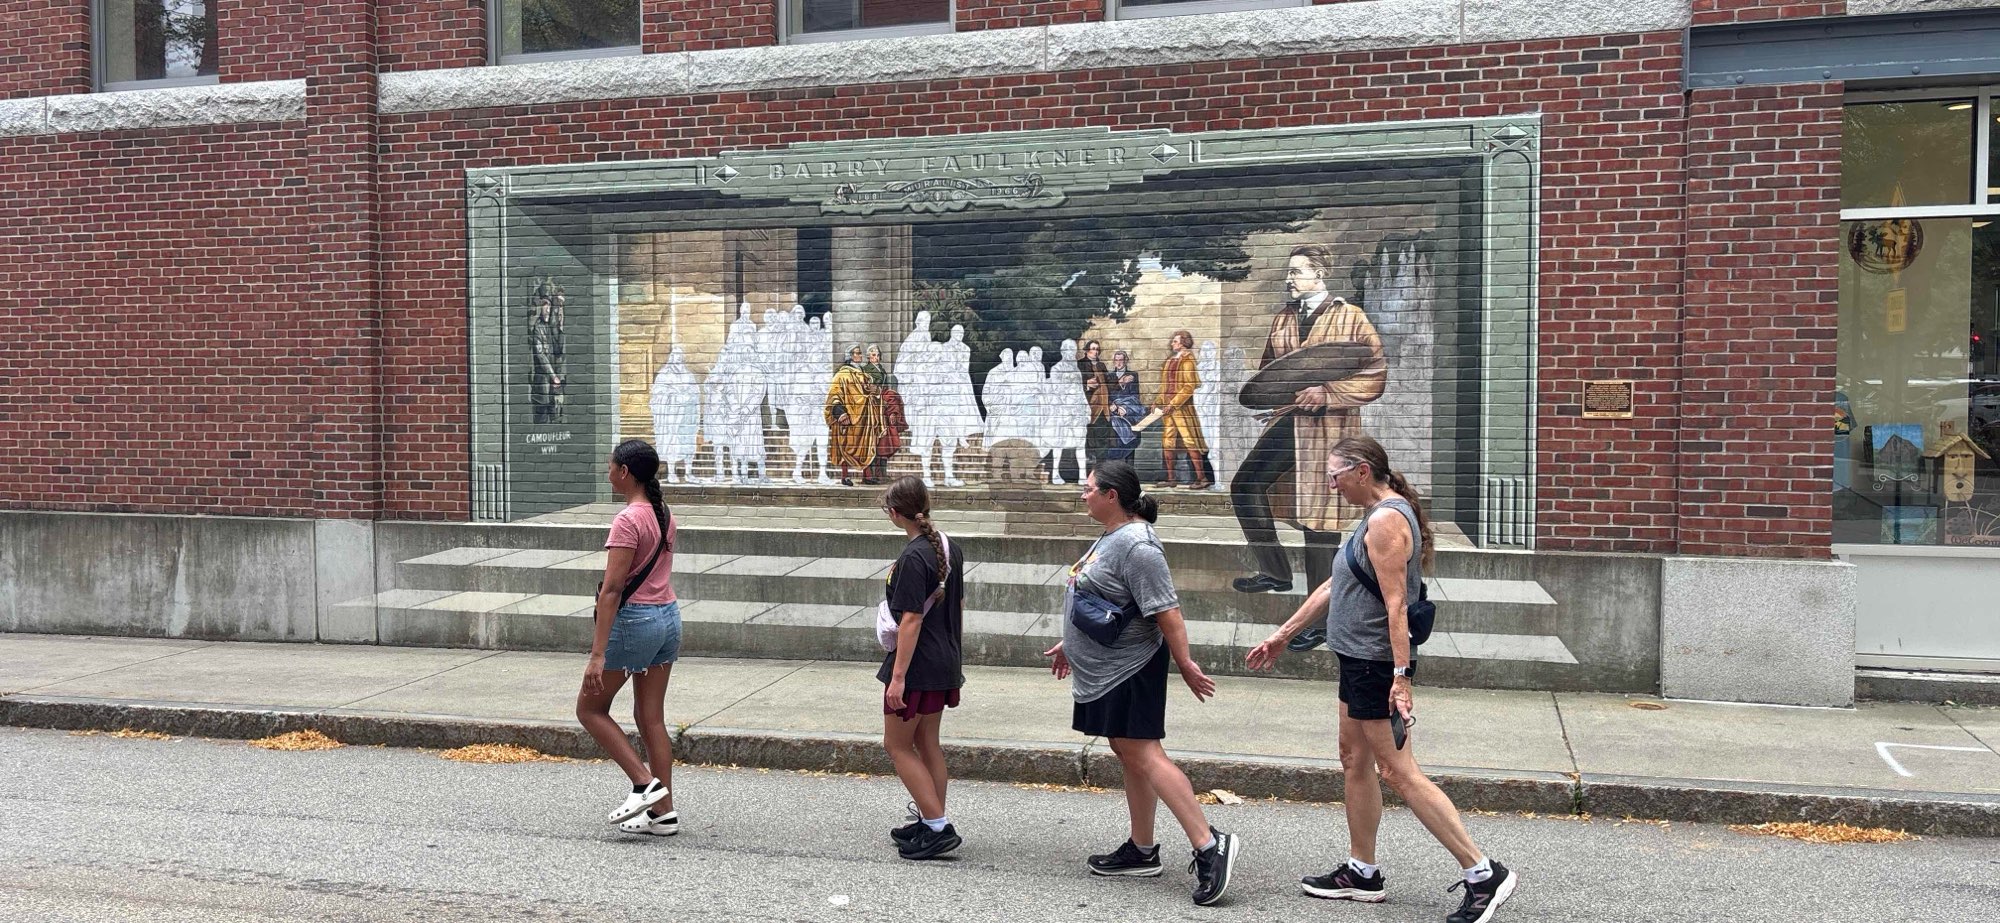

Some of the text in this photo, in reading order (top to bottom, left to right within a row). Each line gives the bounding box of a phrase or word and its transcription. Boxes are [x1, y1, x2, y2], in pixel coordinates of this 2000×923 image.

[769, 147, 1126, 180] BARRY FAULKNER
[904, 178, 971, 193] MURALIST
[991, 187, 1019, 196] 1966
[526, 430, 571, 443] CAMOUFLEUR
[541, 445, 557, 455] WWI
[1217, 834, 1226, 856] HOKA
